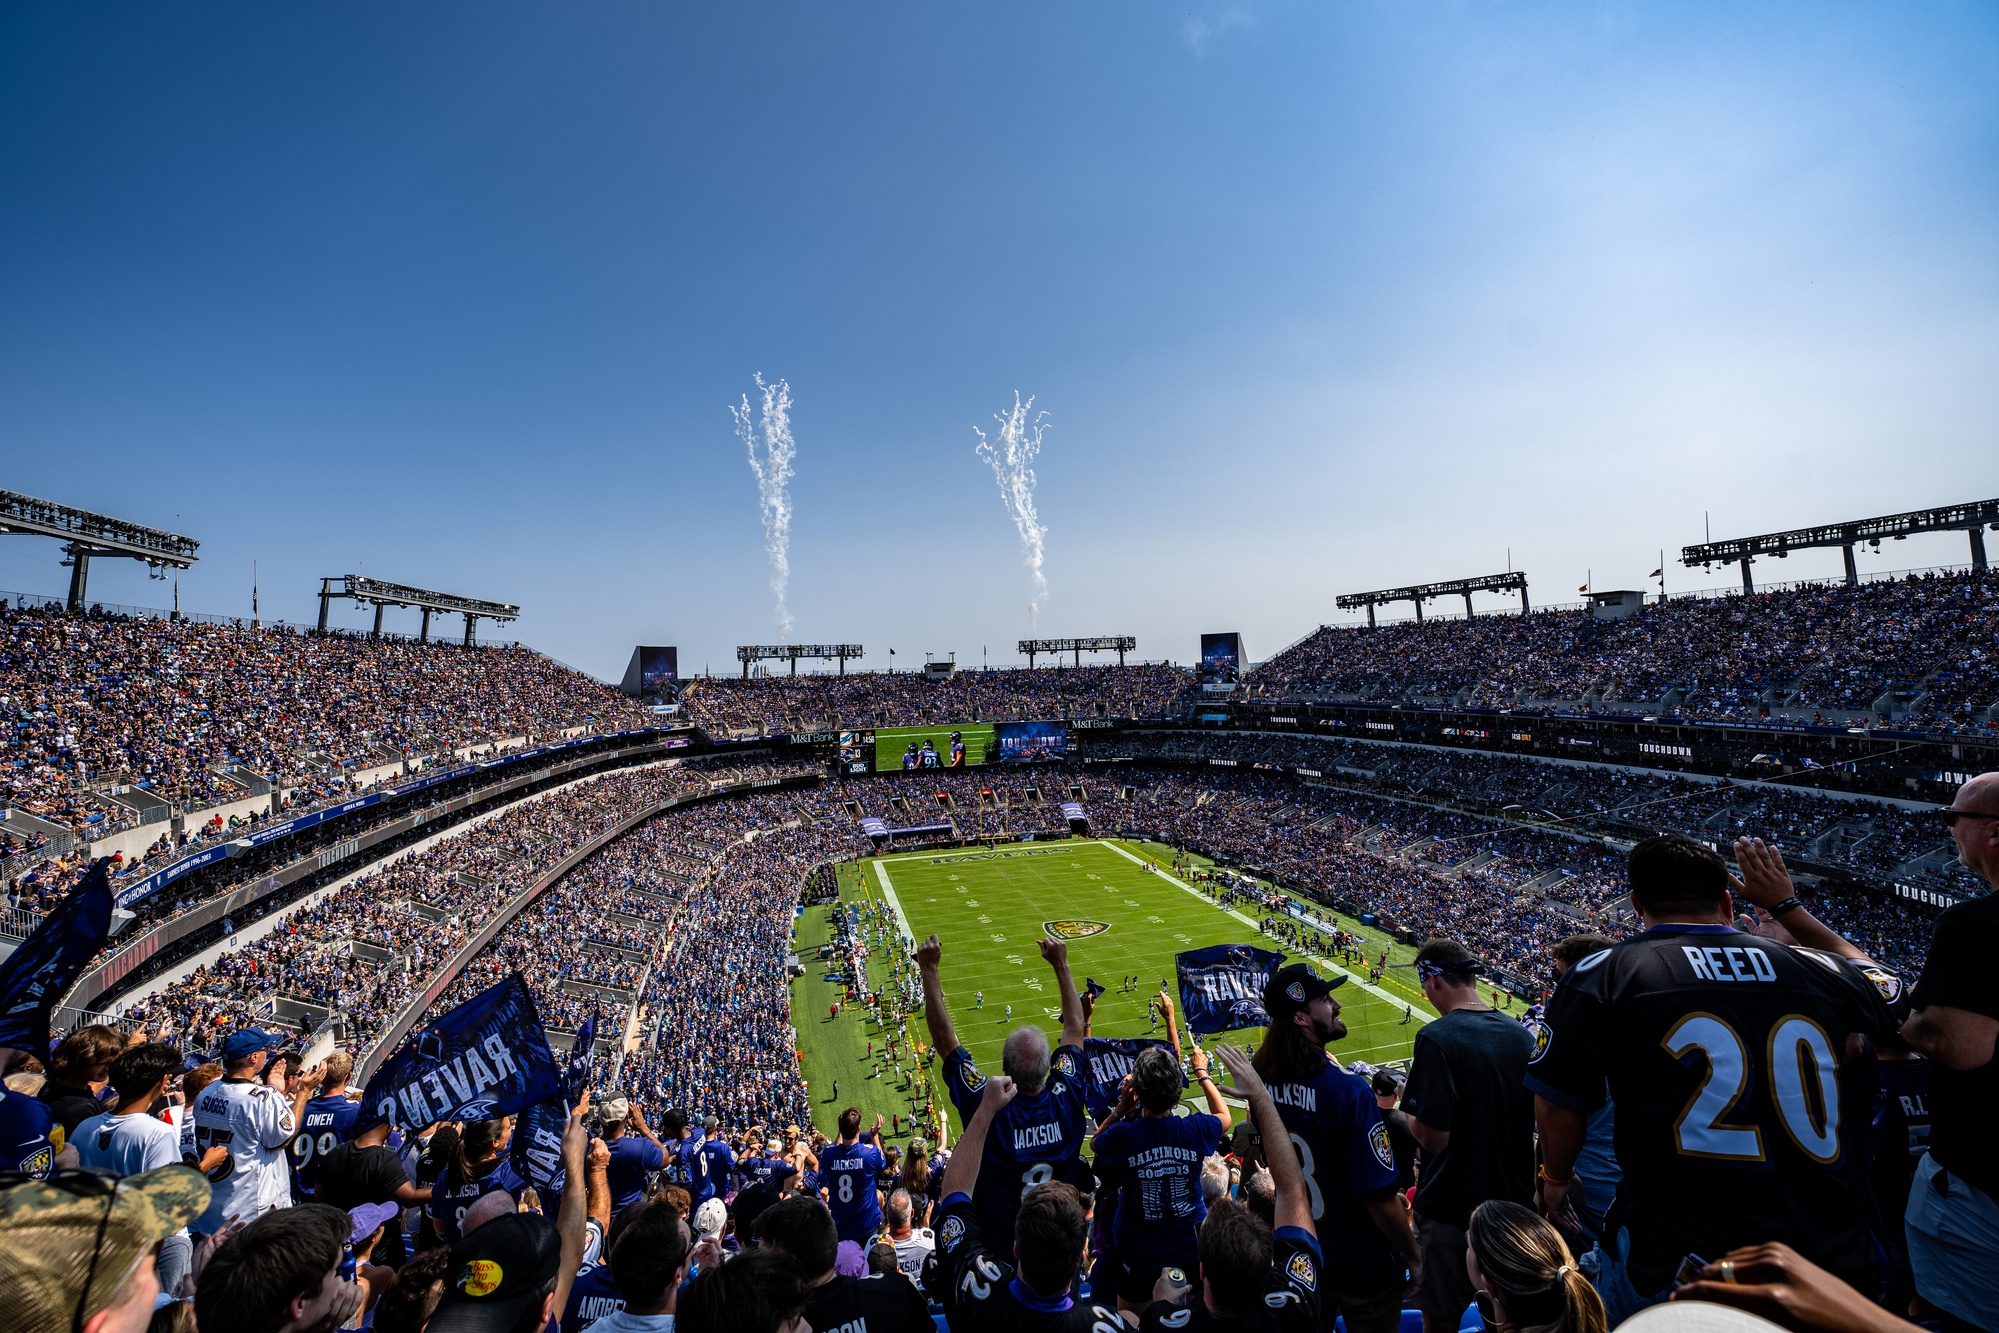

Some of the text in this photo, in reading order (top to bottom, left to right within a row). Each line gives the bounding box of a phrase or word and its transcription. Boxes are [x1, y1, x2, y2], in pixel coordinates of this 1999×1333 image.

[1072, 719, 1114, 729] M&T Bank
[790, 731, 835, 744] M&T Bank
[1001, 735, 1063, 749] TOUCHDOWN
[1956, 736, 1987, 745] FRONTLINE
[1639, 743, 1692, 756] TOUCHDOWN
[924, 756, 937, 768] 93
[190, 852, 212, 868] 1996-2003
[318, 839, 359, 870] TOUCHDOWN
[131, 881, 152, 900] HONOR
[1894, 883, 1960, 908] TOUCHDO
[101, 932, 159, 992] TOUCHDOWN
[1682, 946, 1778, 982] REED
[1022, 978, 1042, 990] 30
[1043, 1006, 1062, 1020] 20
[1659, 1011, 1844, 1164] 20
[200, 1095, 229, 1116] SUGGS
[306, 1113, 334, 1127] OWEH
[1014, 1121, 1063, 1150] JACKSON
[294, 1132, 338, 1171] 99
[1128, 1146, 1198, 1168] BALTIMORE
[700, 1151, 708, 1178] 8
[830, 1158, 864, 1171] JACKSON
[1138, 1169, 1154, 1179] 20
[1176, 1164, 1190, 1176] 13
[838, 1174, 854, 1204] 8
[472, 1261, 494, 1272] Bass
[472, 1272, 488, 1282] Pro
[472, 1280, 498, 1292] Shops
